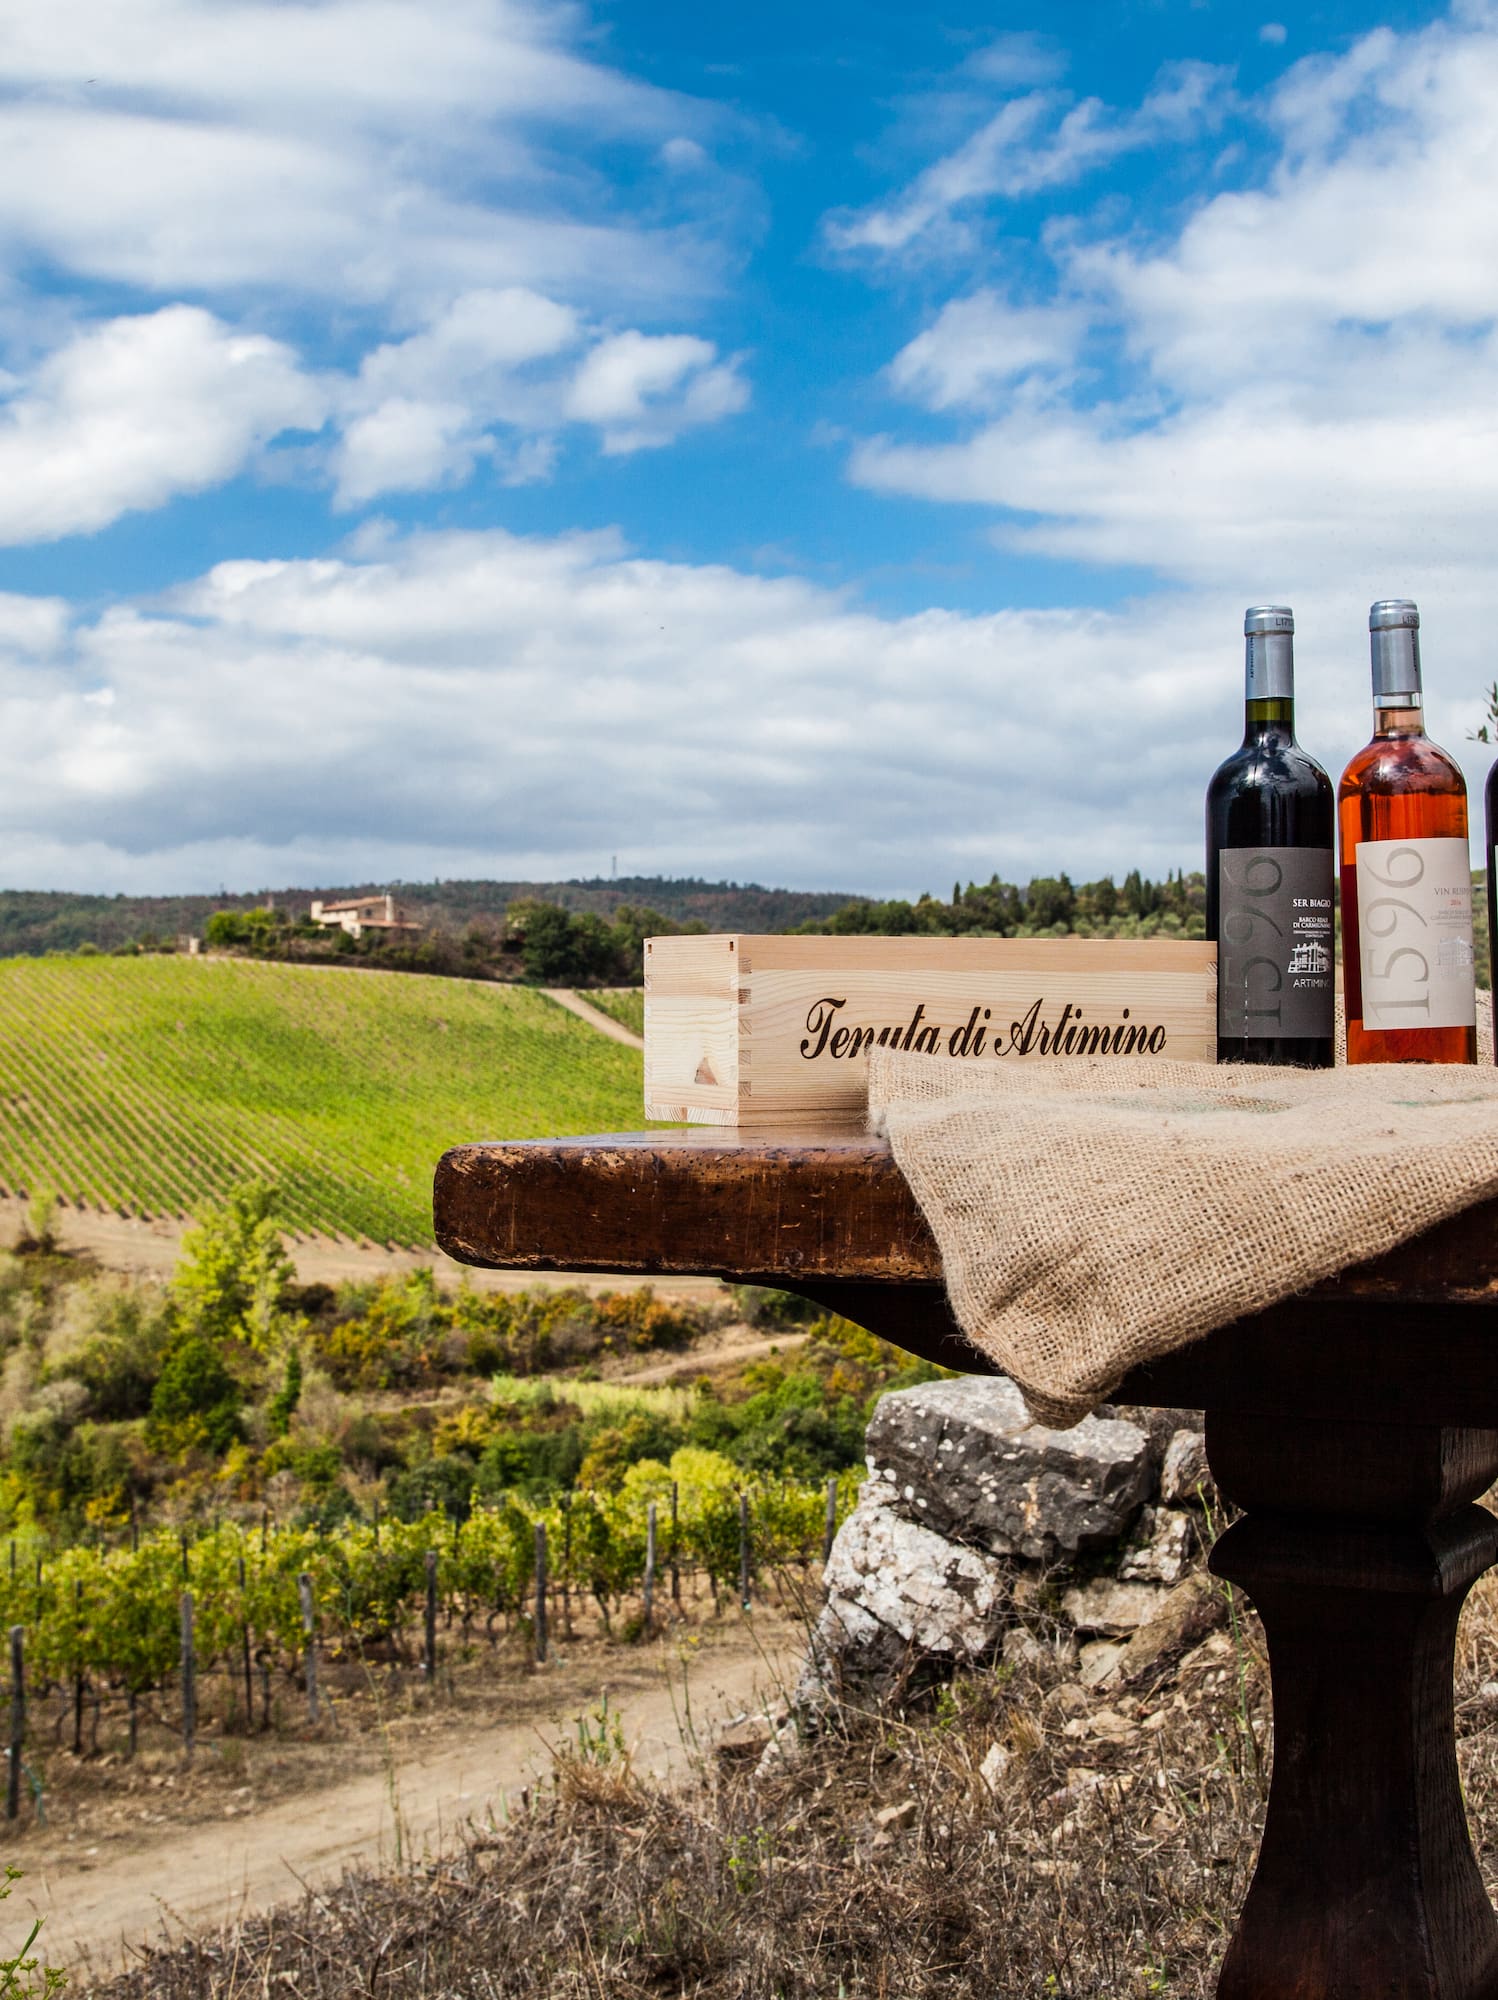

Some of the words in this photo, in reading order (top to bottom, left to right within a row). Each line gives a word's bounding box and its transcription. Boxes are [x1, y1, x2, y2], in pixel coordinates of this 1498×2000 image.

[1292, 898, 1308, 907] SER
[1433, 887, 1450, 895] VIN
[1224, 855, 1283, 1028] 1596
[1363, 847, 1431, 1021] 1596
[1293, 978, 1329, 988] ARTIMIN
[800, 998, 941, 1059] Tenuta
[949, 1006, 991, 1056] di
[994, 998, 1167, 1056] Artimino
